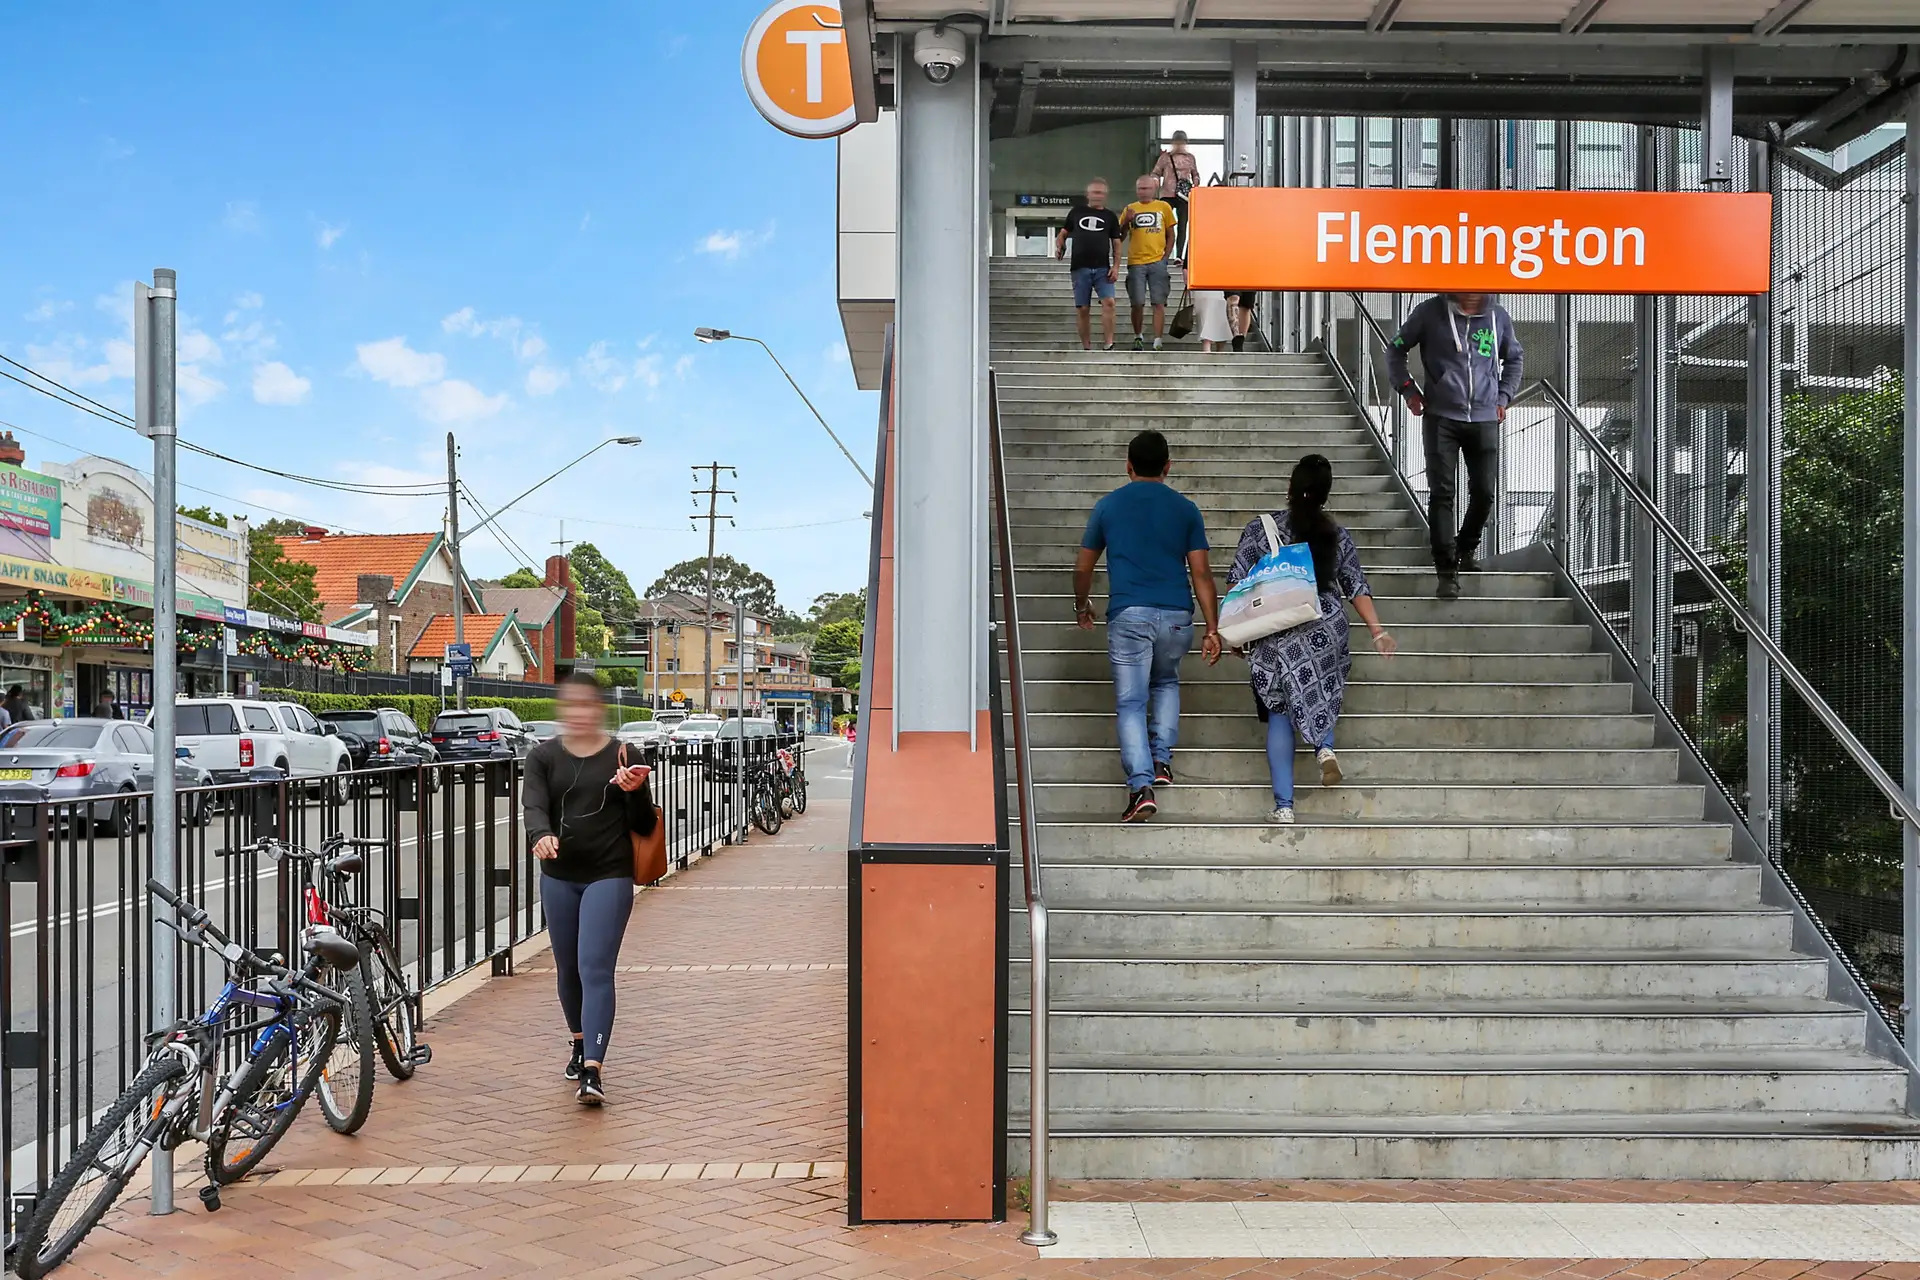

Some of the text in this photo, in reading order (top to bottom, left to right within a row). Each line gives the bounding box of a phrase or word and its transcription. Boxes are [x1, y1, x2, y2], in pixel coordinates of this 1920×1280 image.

[786, 31, 841, 103] T
[1040, 196, 1049, 204] To
[1316, 211, 1645, 279] Flemington
[9, 471, 57, 502] RESTAURANT
[0, 561, 68, 588] APPY SNACK
[1257, 561, 1308, 576] BEACHES
